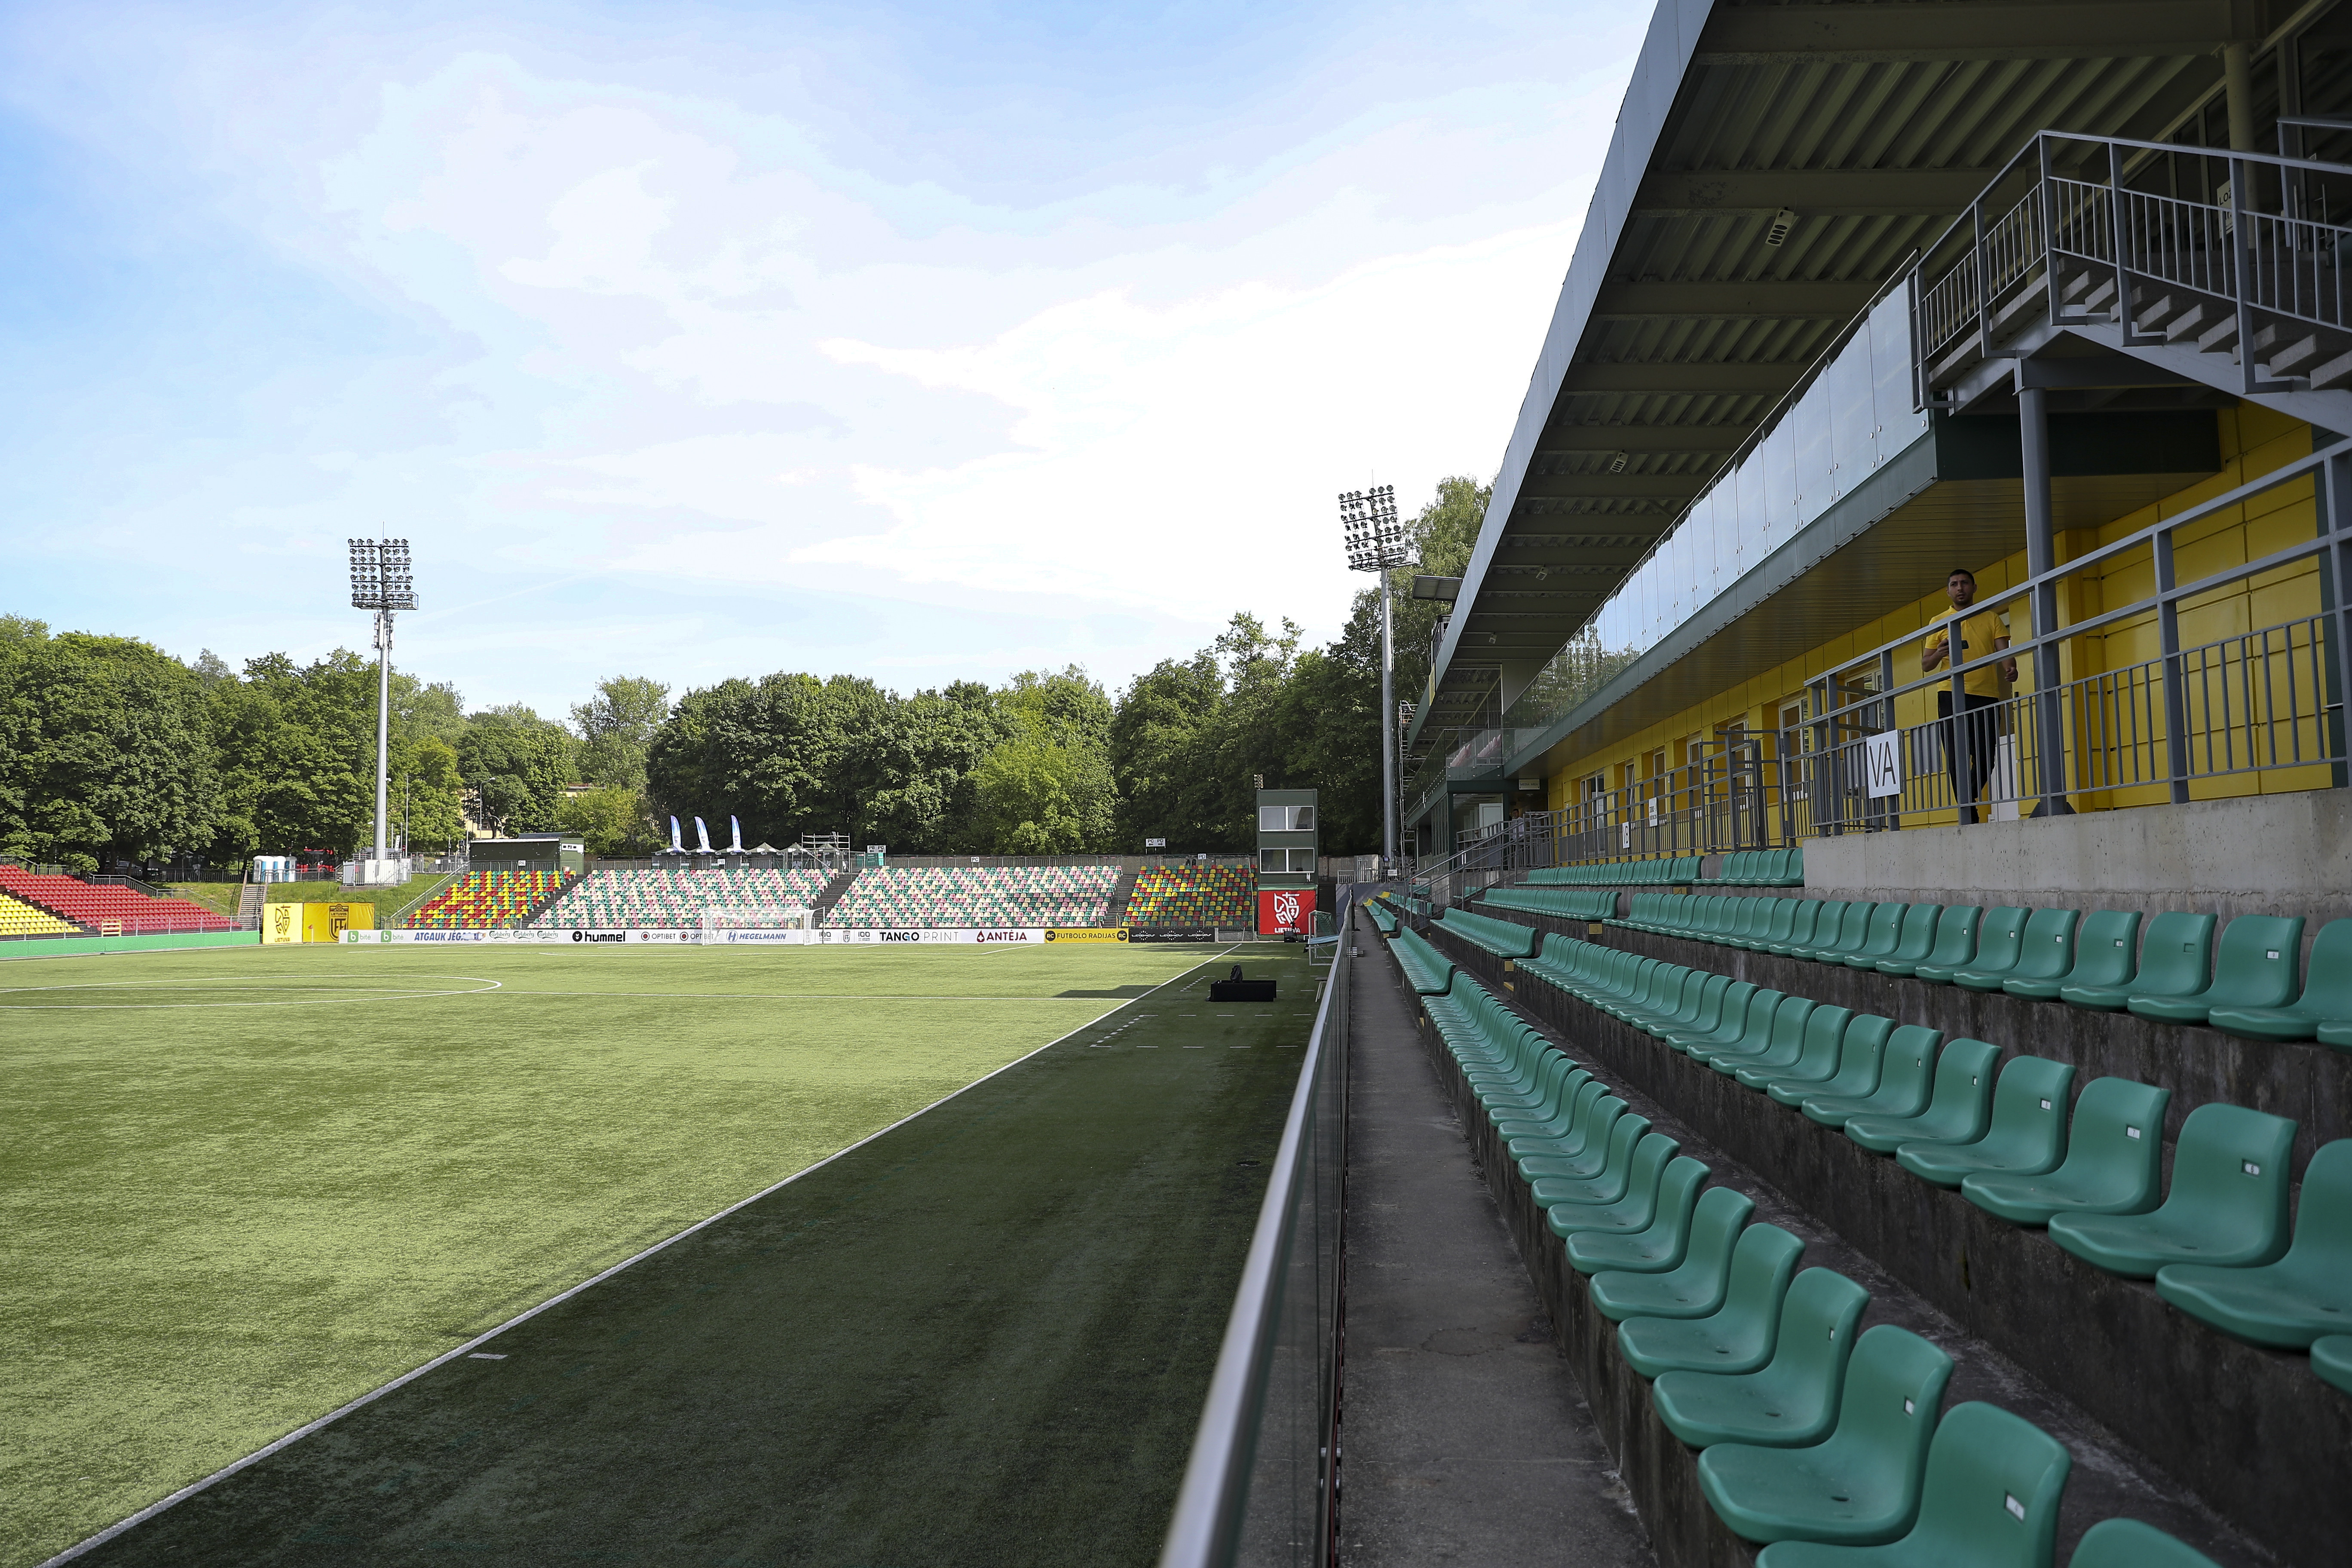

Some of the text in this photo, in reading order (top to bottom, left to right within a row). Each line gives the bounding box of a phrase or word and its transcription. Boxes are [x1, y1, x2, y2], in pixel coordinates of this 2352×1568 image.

[1868, 741, 1896, 788] VA
[1623, 825, 1629, 844] VB
[1592, 924, 1599, 933] 3
[414, 932, 447, 941] ATGAUK
[489, 931, 511, 939] Carlsberg
[513, 931, 535, 939] Carlsberg
[537, 931, 558, 939] Carlsberg
[585, 931, 626, 942] hummel
[879, 931, 959, 941] TANGO PRINT
[986, 930, 1027, 941] ANTĖJA
